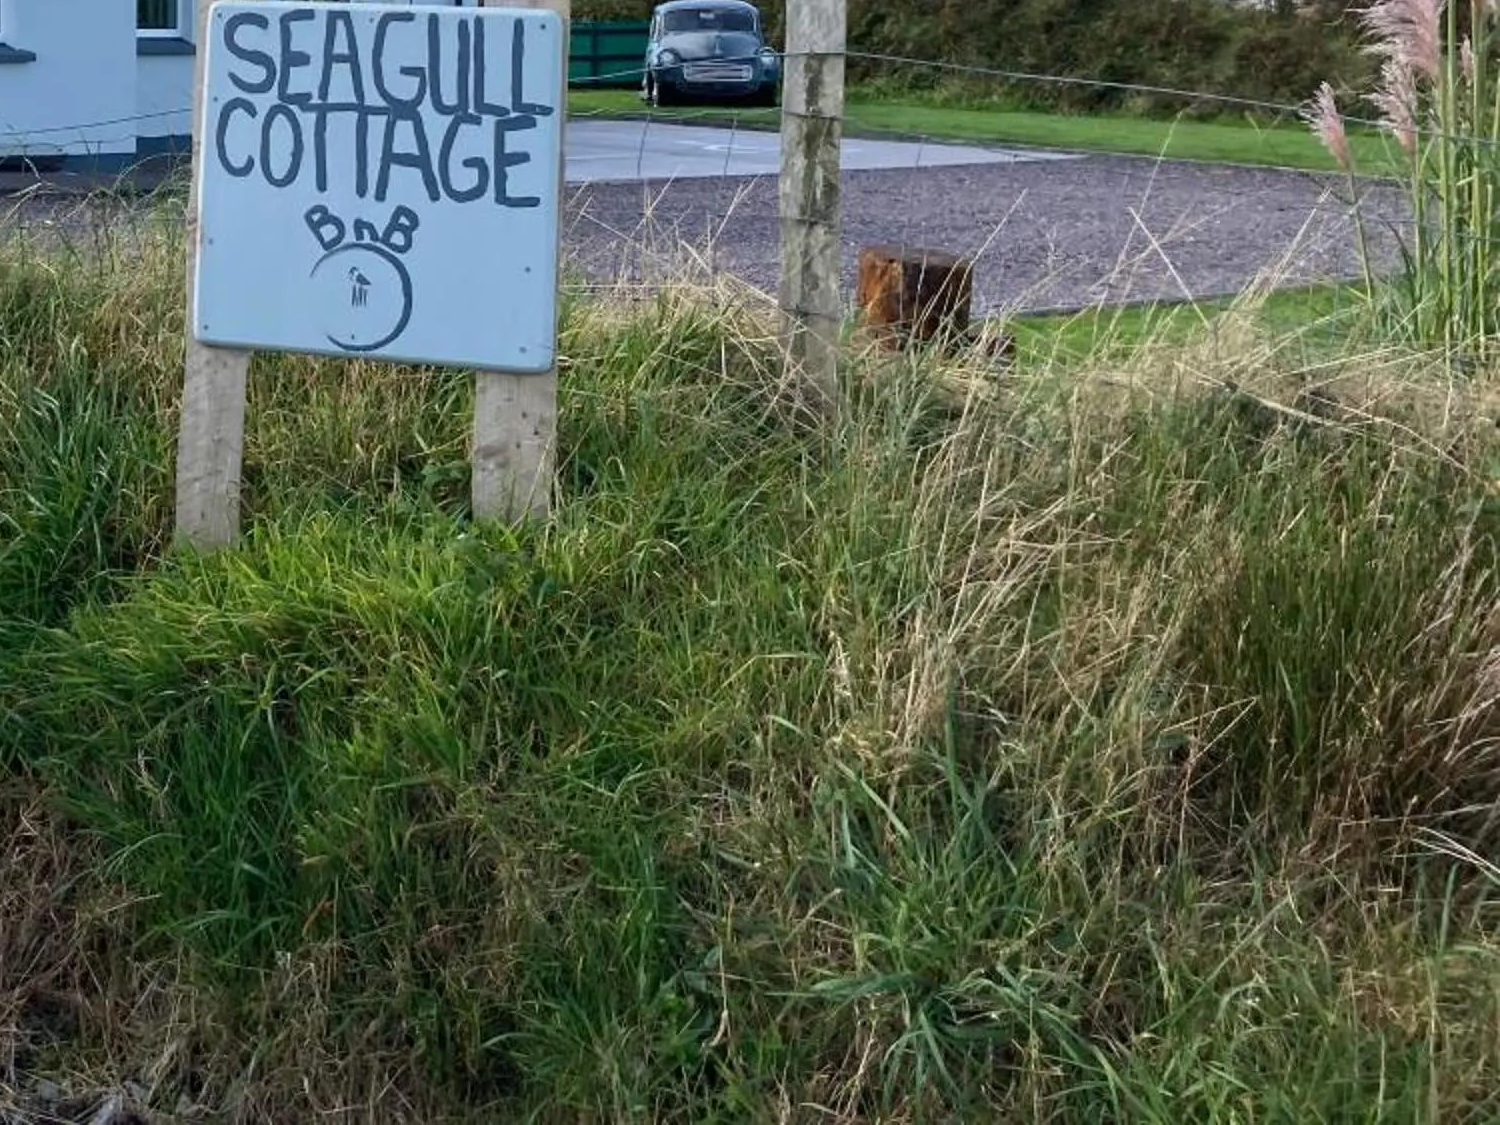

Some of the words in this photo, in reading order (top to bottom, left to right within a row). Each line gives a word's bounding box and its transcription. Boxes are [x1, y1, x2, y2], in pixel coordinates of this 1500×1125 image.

[223, 9, 554, 116] SEAGULL
[216, 97, 541, 207] COTTAGE
[304, 204, 419, 254] BnB
